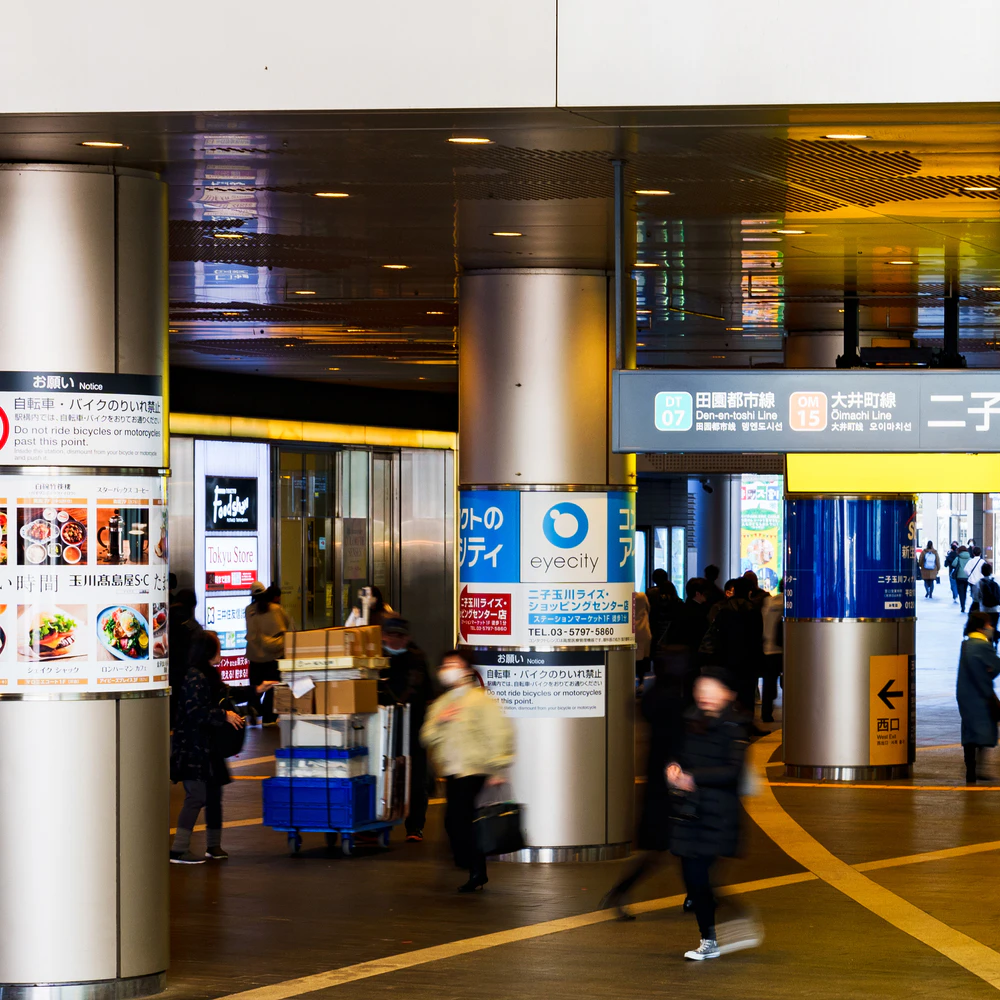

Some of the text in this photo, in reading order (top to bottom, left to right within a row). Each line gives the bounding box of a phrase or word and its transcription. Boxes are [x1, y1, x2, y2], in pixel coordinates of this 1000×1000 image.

[33, 376, 74, 389] お願い
[14, 397, 161, 413] 自転車・バイクのりいれ禁止
[666, 397, 682, 407] DT
[696, 392, 775, 409] 田園都市線
[798, 397, 819, 407] OM
[831, 392, 896, 409] 大井町線
[662, 411, 684, 426] 07
[696, 410, 778, 421] Den-en-toshi Line
[798, 411, 820, 426] 15
[872, 410, 892, 420] Line
[14, 426, 28, 434] Do
[31, 426, 48, 434] not
[51, 426, 71, 434] ride
[73, 426, 112, 437] bicycles
[124, 429, 161, 438] motorcycles
[14, 438, 89, 447] past this point.
[208, 546, 253, 566] Tokyu Store
[619, 537, 634, 568] ア
[530, 552, 599, 573] eyecity
[528, 600, 629, 611] ショッピングセンター店
[533, 614, 610, 623] ステーションマーケット1F
[528, 627, 614, 637] TEL.03-5797-5860
[497, 654, 524, 664] お願い
[101, 665, 133, 673] ロンハーマン
[487, 669, 602, 679] 自転車・バイクのりいれ禁止
[522, 690, 552, 698] bicycles
[877, 718, 900, 731] 西口
